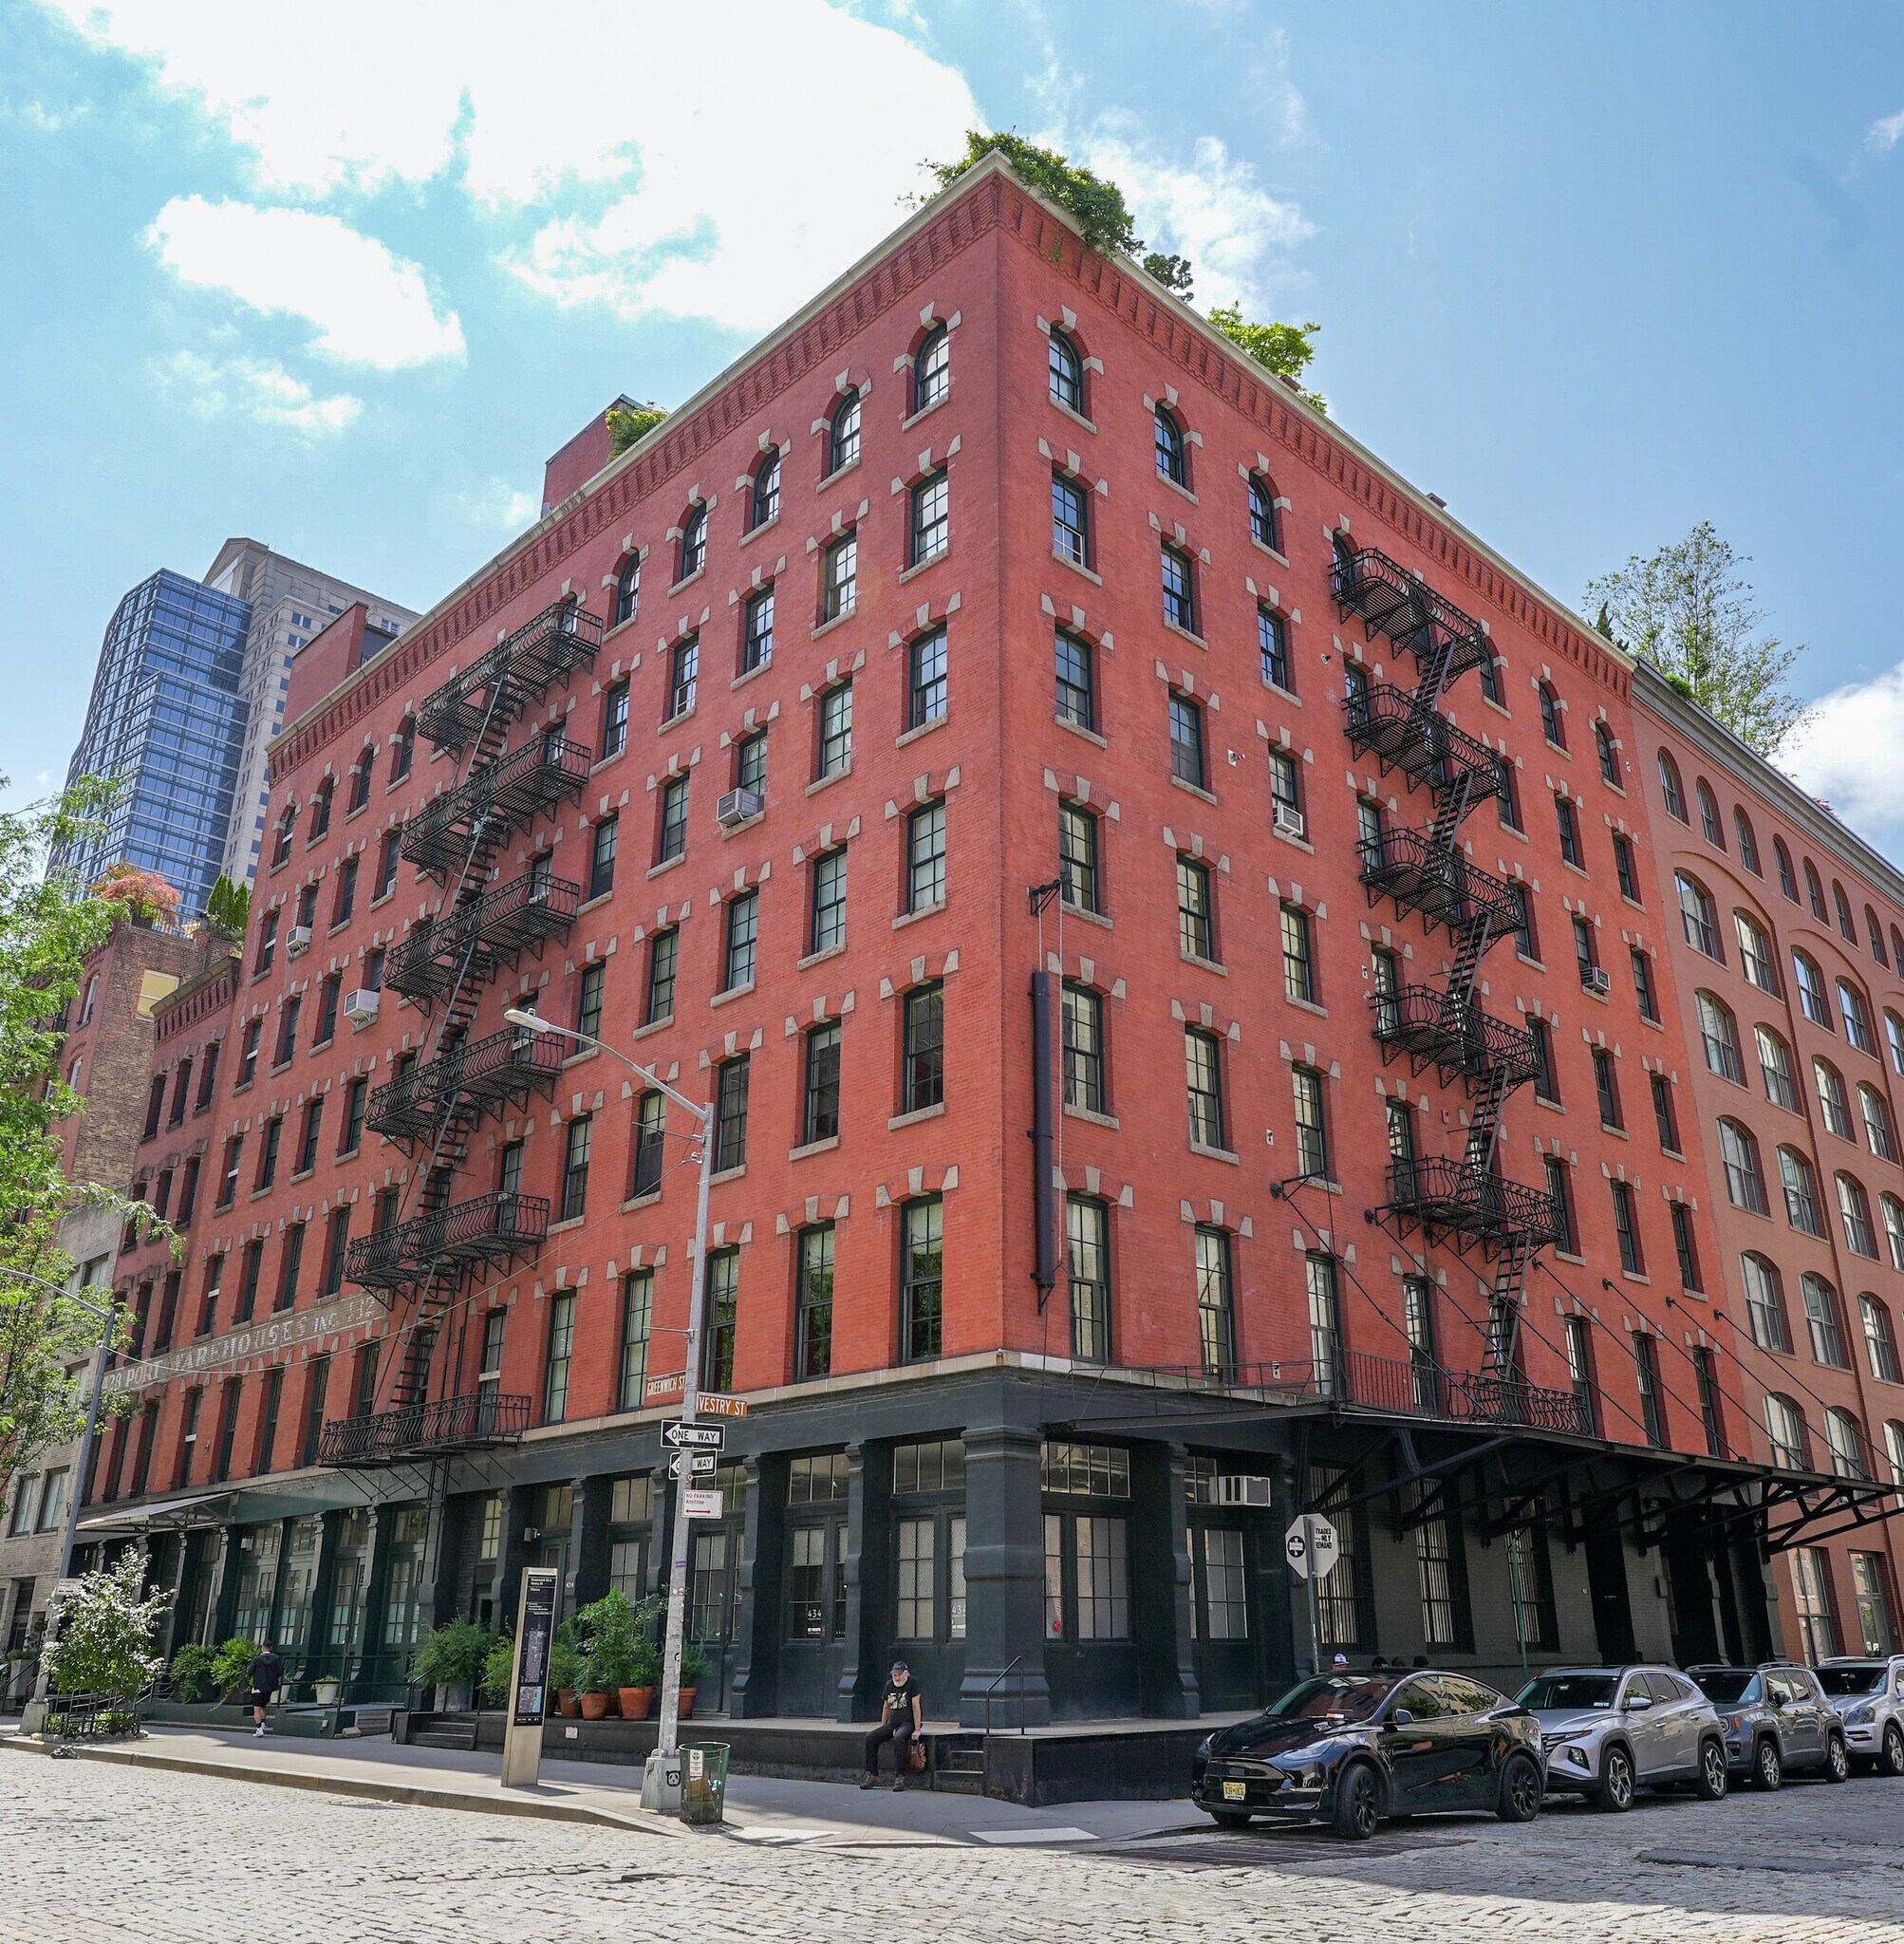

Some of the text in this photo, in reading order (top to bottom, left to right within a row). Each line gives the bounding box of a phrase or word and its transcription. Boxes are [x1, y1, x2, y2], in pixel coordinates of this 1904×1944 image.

[125, 1359, 163, 1388] PORT
[646, 1374, 686, 1397] GREENWICH ST
[698, 1395, 747, 1416] VESTRY ST
[671, 1430, 717, 1443] ONE WAY
[696, 1458, 713, 1469] WAY
[807, 1609, 822, 1618] 434
